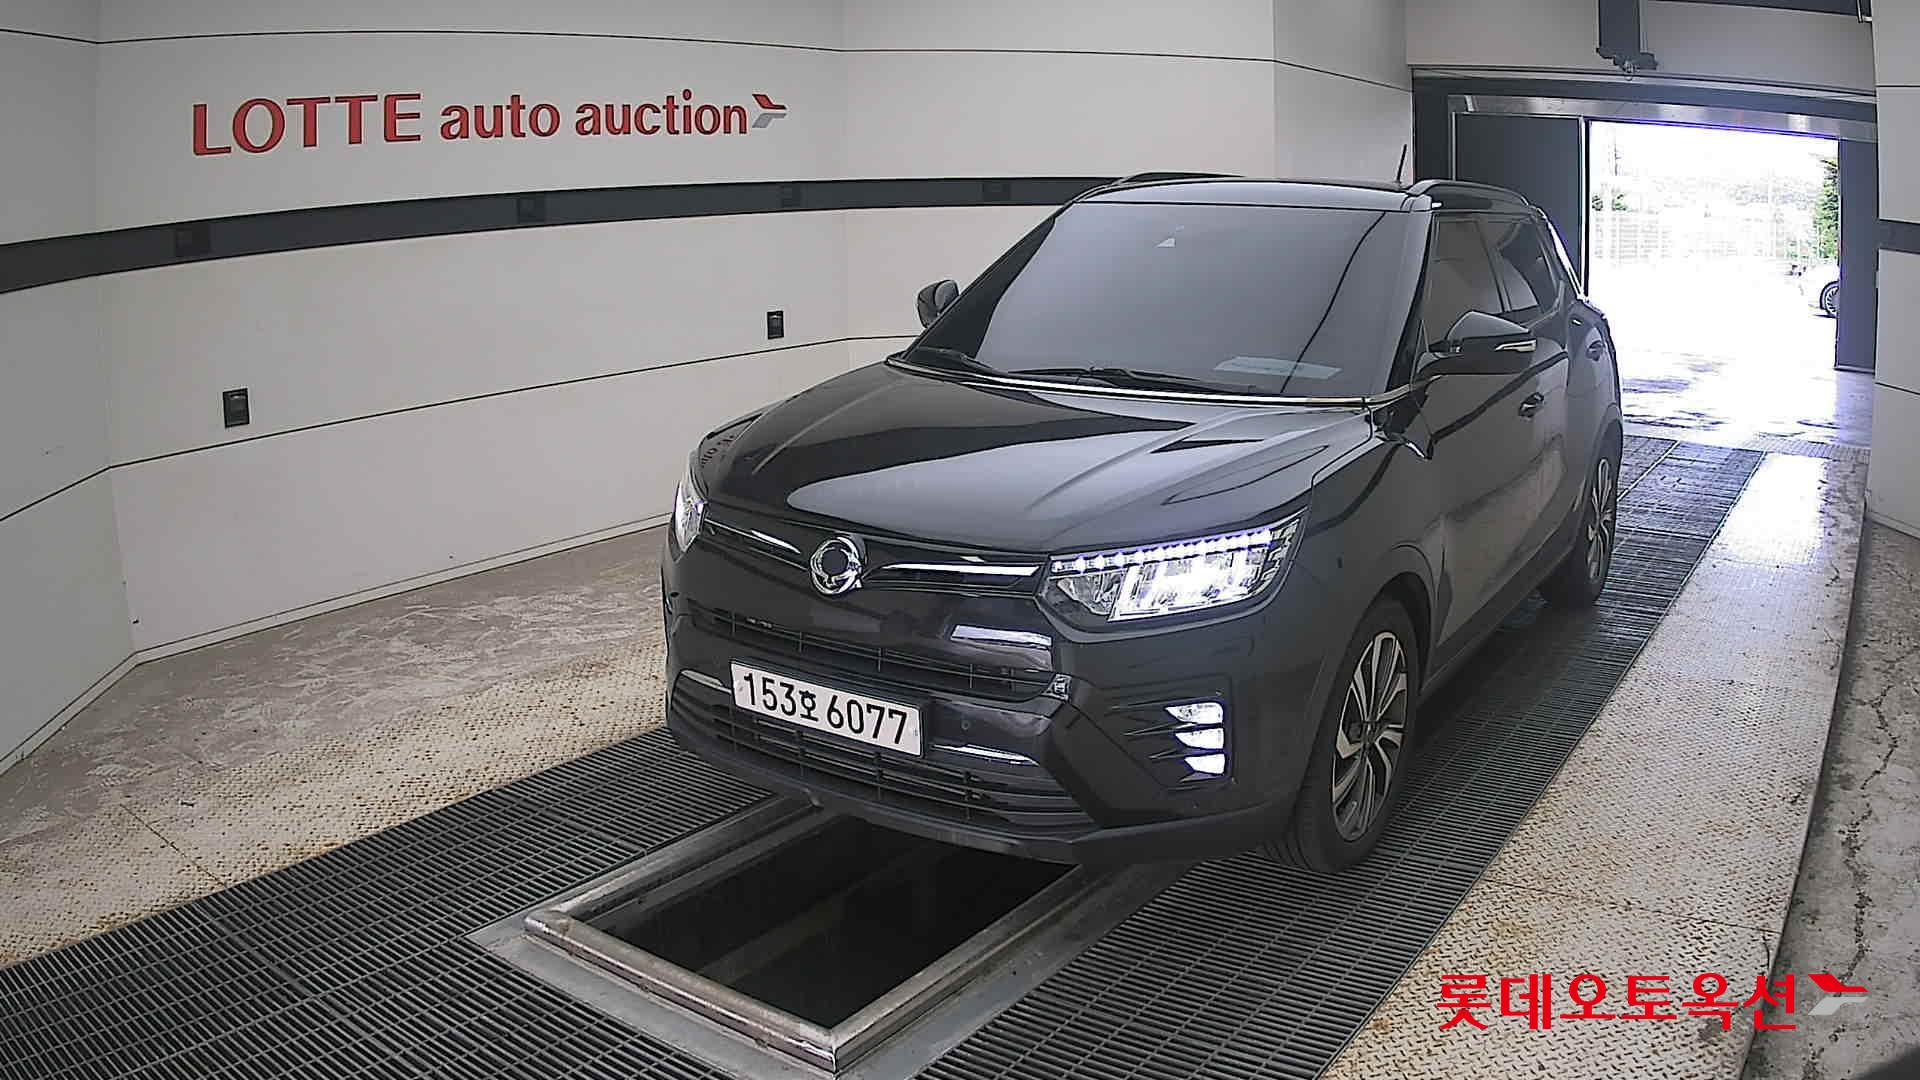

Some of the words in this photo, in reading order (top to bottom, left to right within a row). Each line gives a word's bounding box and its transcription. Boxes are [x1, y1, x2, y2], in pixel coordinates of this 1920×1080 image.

[193, 93, 421, 156] LOTTE
[440, 95, 561, 140] auto
[574, 89, 748, 136] auction
[827, 695, 907, 744] 6077
